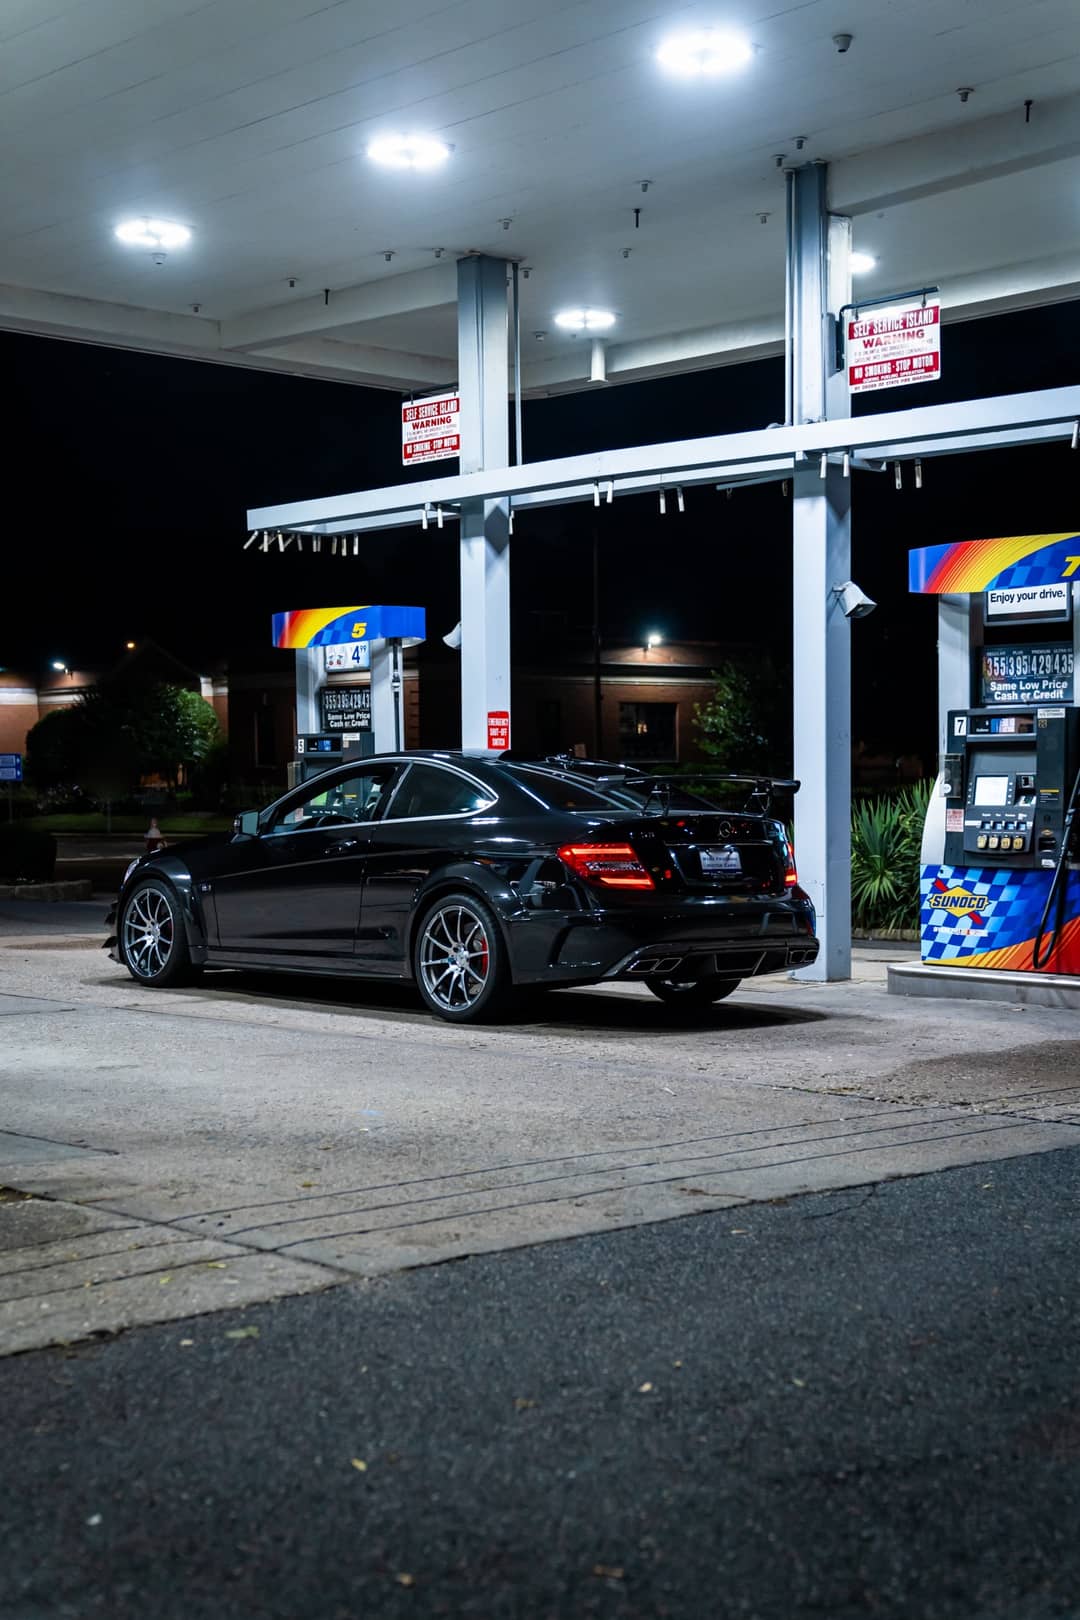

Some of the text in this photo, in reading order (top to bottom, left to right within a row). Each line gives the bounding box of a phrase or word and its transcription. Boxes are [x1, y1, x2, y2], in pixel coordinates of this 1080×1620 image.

[853, 309, 934, 338] SELF SERVICE ISLAND
[863, 329, 925, 348] WARNING
[854, 367, 863, 379] NO
[864, 362, 892, 378] SMOKING
[895, 359, 911, 372] STOP
[912, 354, 934, 369] MOTOR
[406, 400, 457, 421] SELF SERVICE ISLAND
[412, 416, 452, 430] WARNING
[990, 588, 1066, 604] Enjoy your drive.
[351, 622, 368, 639] 5
[990, 680, 1068, 691] Same Low Price
[994, 689, 1064, 701] Cash or Credit
[343, 712, 355, 720] Low
[356, 711, 371, 719] Price
[330, 719, 344, 728] Cash
[351, 719, 369, 727] Credit
[956, 719, 965, 733] 7
[932, 895, 986, 909] SUNOCO
